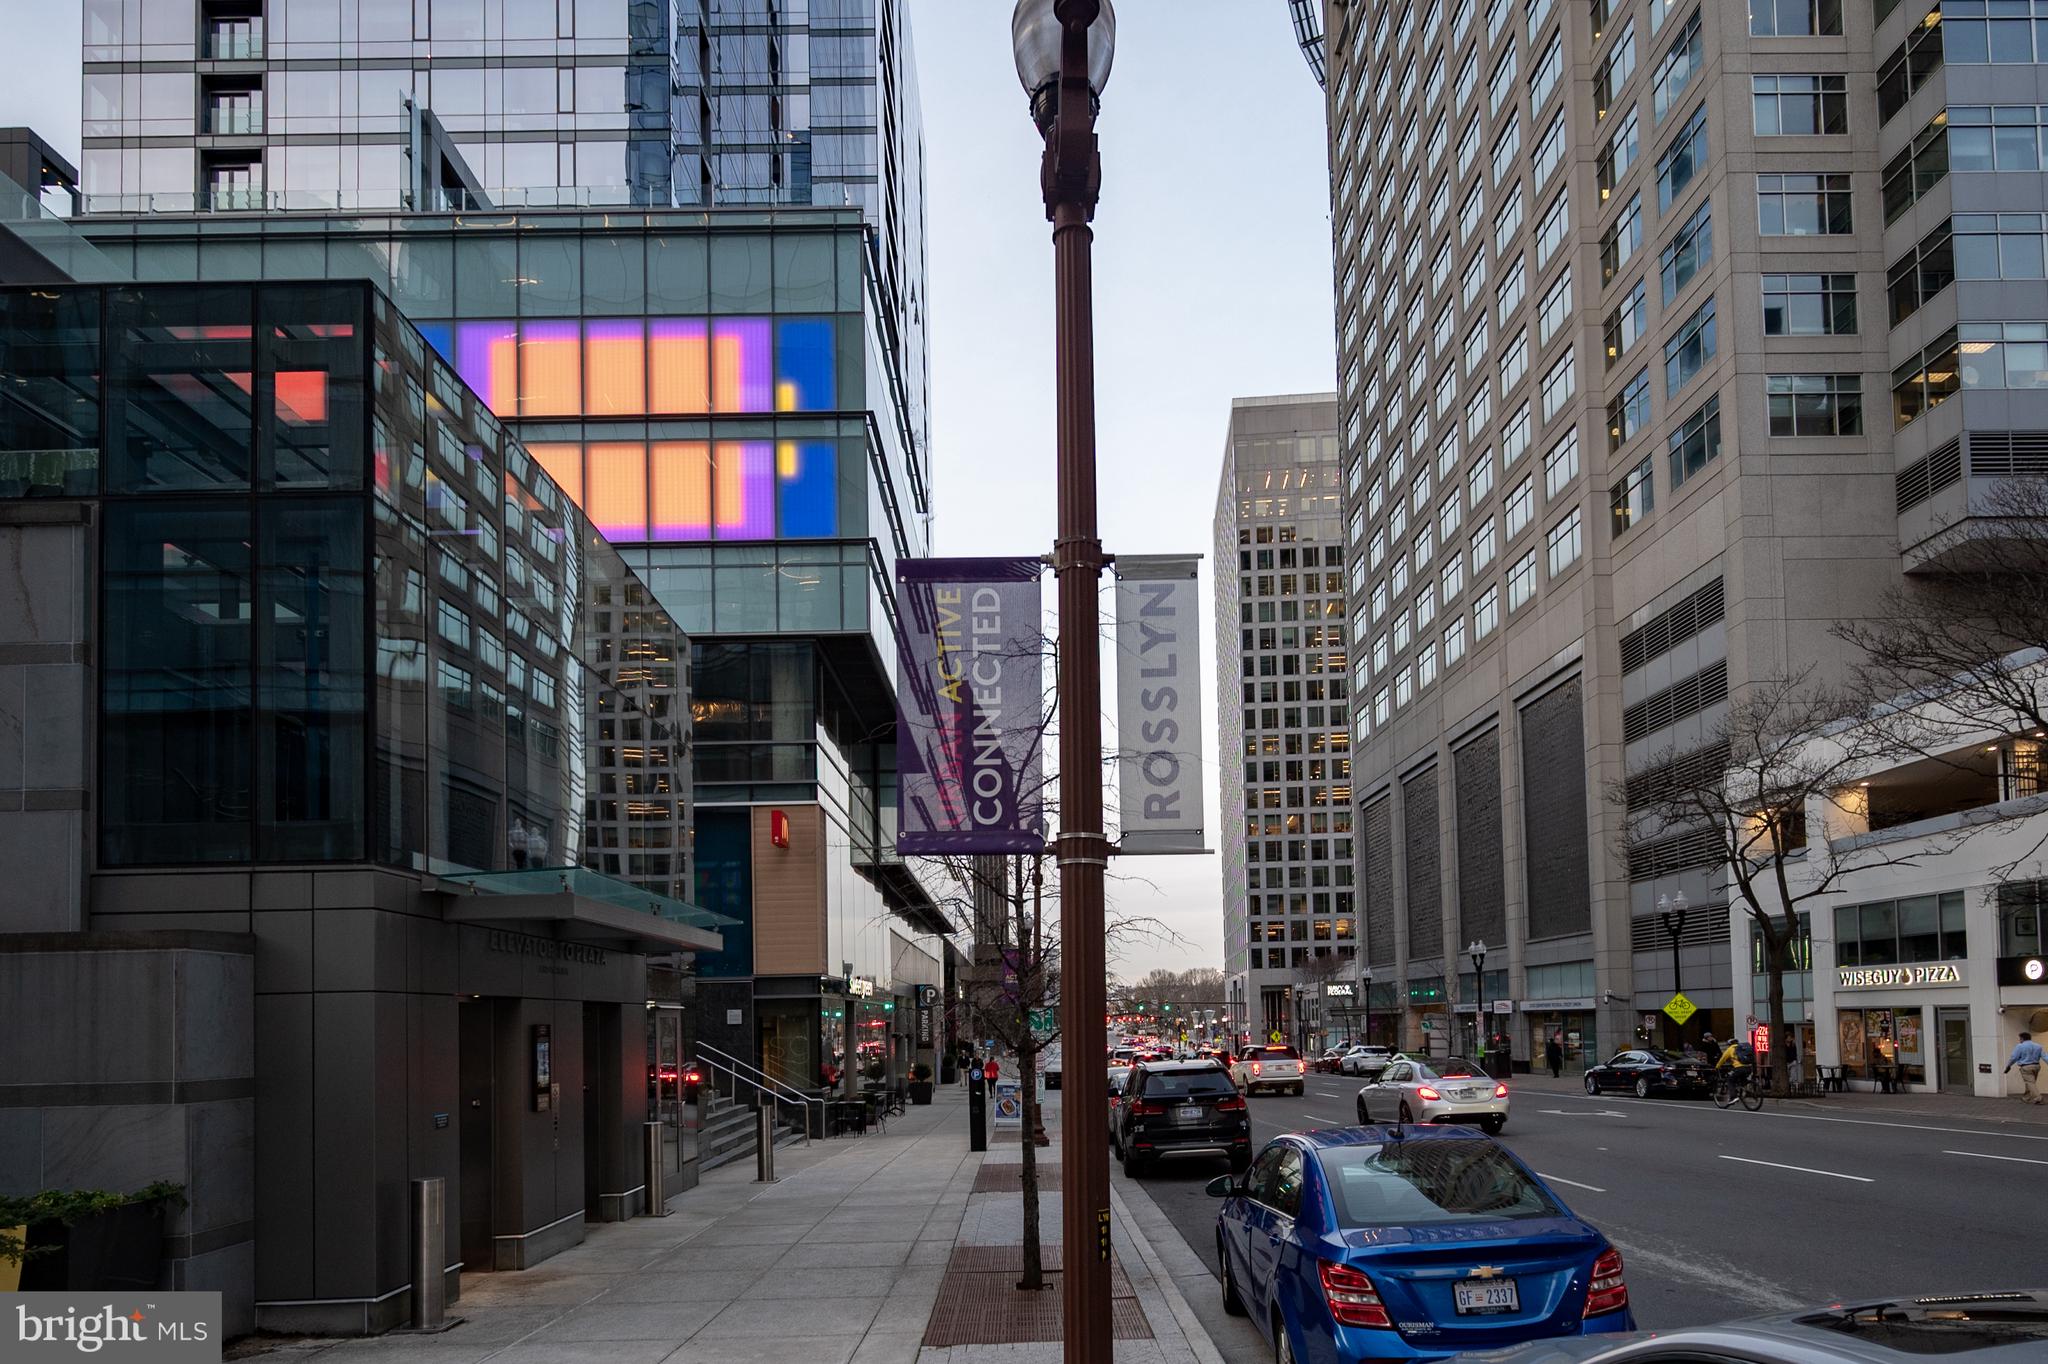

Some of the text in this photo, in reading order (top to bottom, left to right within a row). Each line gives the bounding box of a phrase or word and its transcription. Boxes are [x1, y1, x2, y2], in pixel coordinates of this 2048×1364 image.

[937, 587, 962, 704] ACTIVE
[972, 587, 1002, 826] CONNECTED
[1139, 583, 1180, 820] ROSSLYN
[1839, 965, 1961, 987] WISEGUY PIZZA
[920, 1009, 930, 1042] PARKING
[1458, 1288, 1513, 1306] GF 2337
